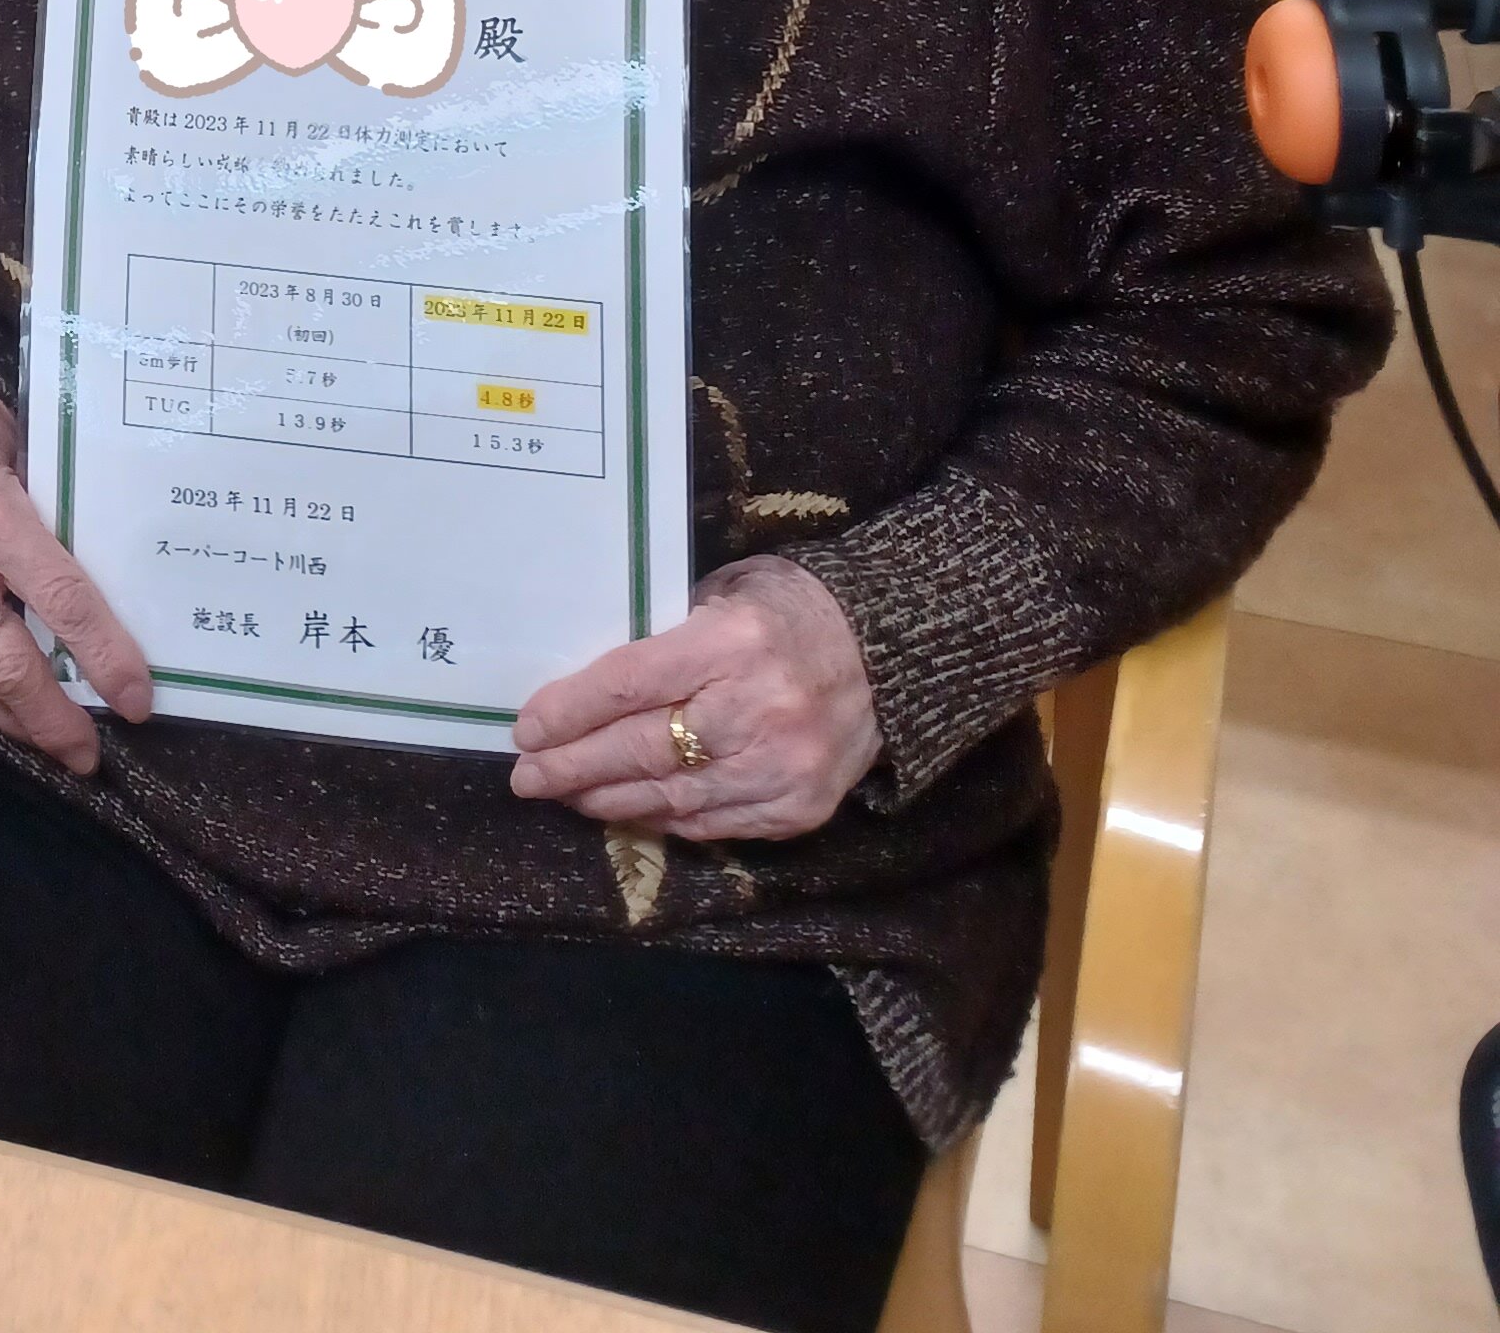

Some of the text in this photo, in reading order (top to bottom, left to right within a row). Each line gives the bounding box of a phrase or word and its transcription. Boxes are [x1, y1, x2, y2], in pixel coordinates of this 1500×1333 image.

[473, 16, 526, 63] 殿
[286, 324, 335, 346] (初回)
[144, 395, 192, 415] TUG
[479, 390, 535, 410] 4.8秒
[278, 412, 347, 434] 13.9秒
[473, 434, 545, 455] 15.3秒
[170, 486, 356, 523] 2023年11月22日
[156, 540, 328, 576] スーパーコート川西
[192, 607, 458, 666] 施設長 岸本 優
